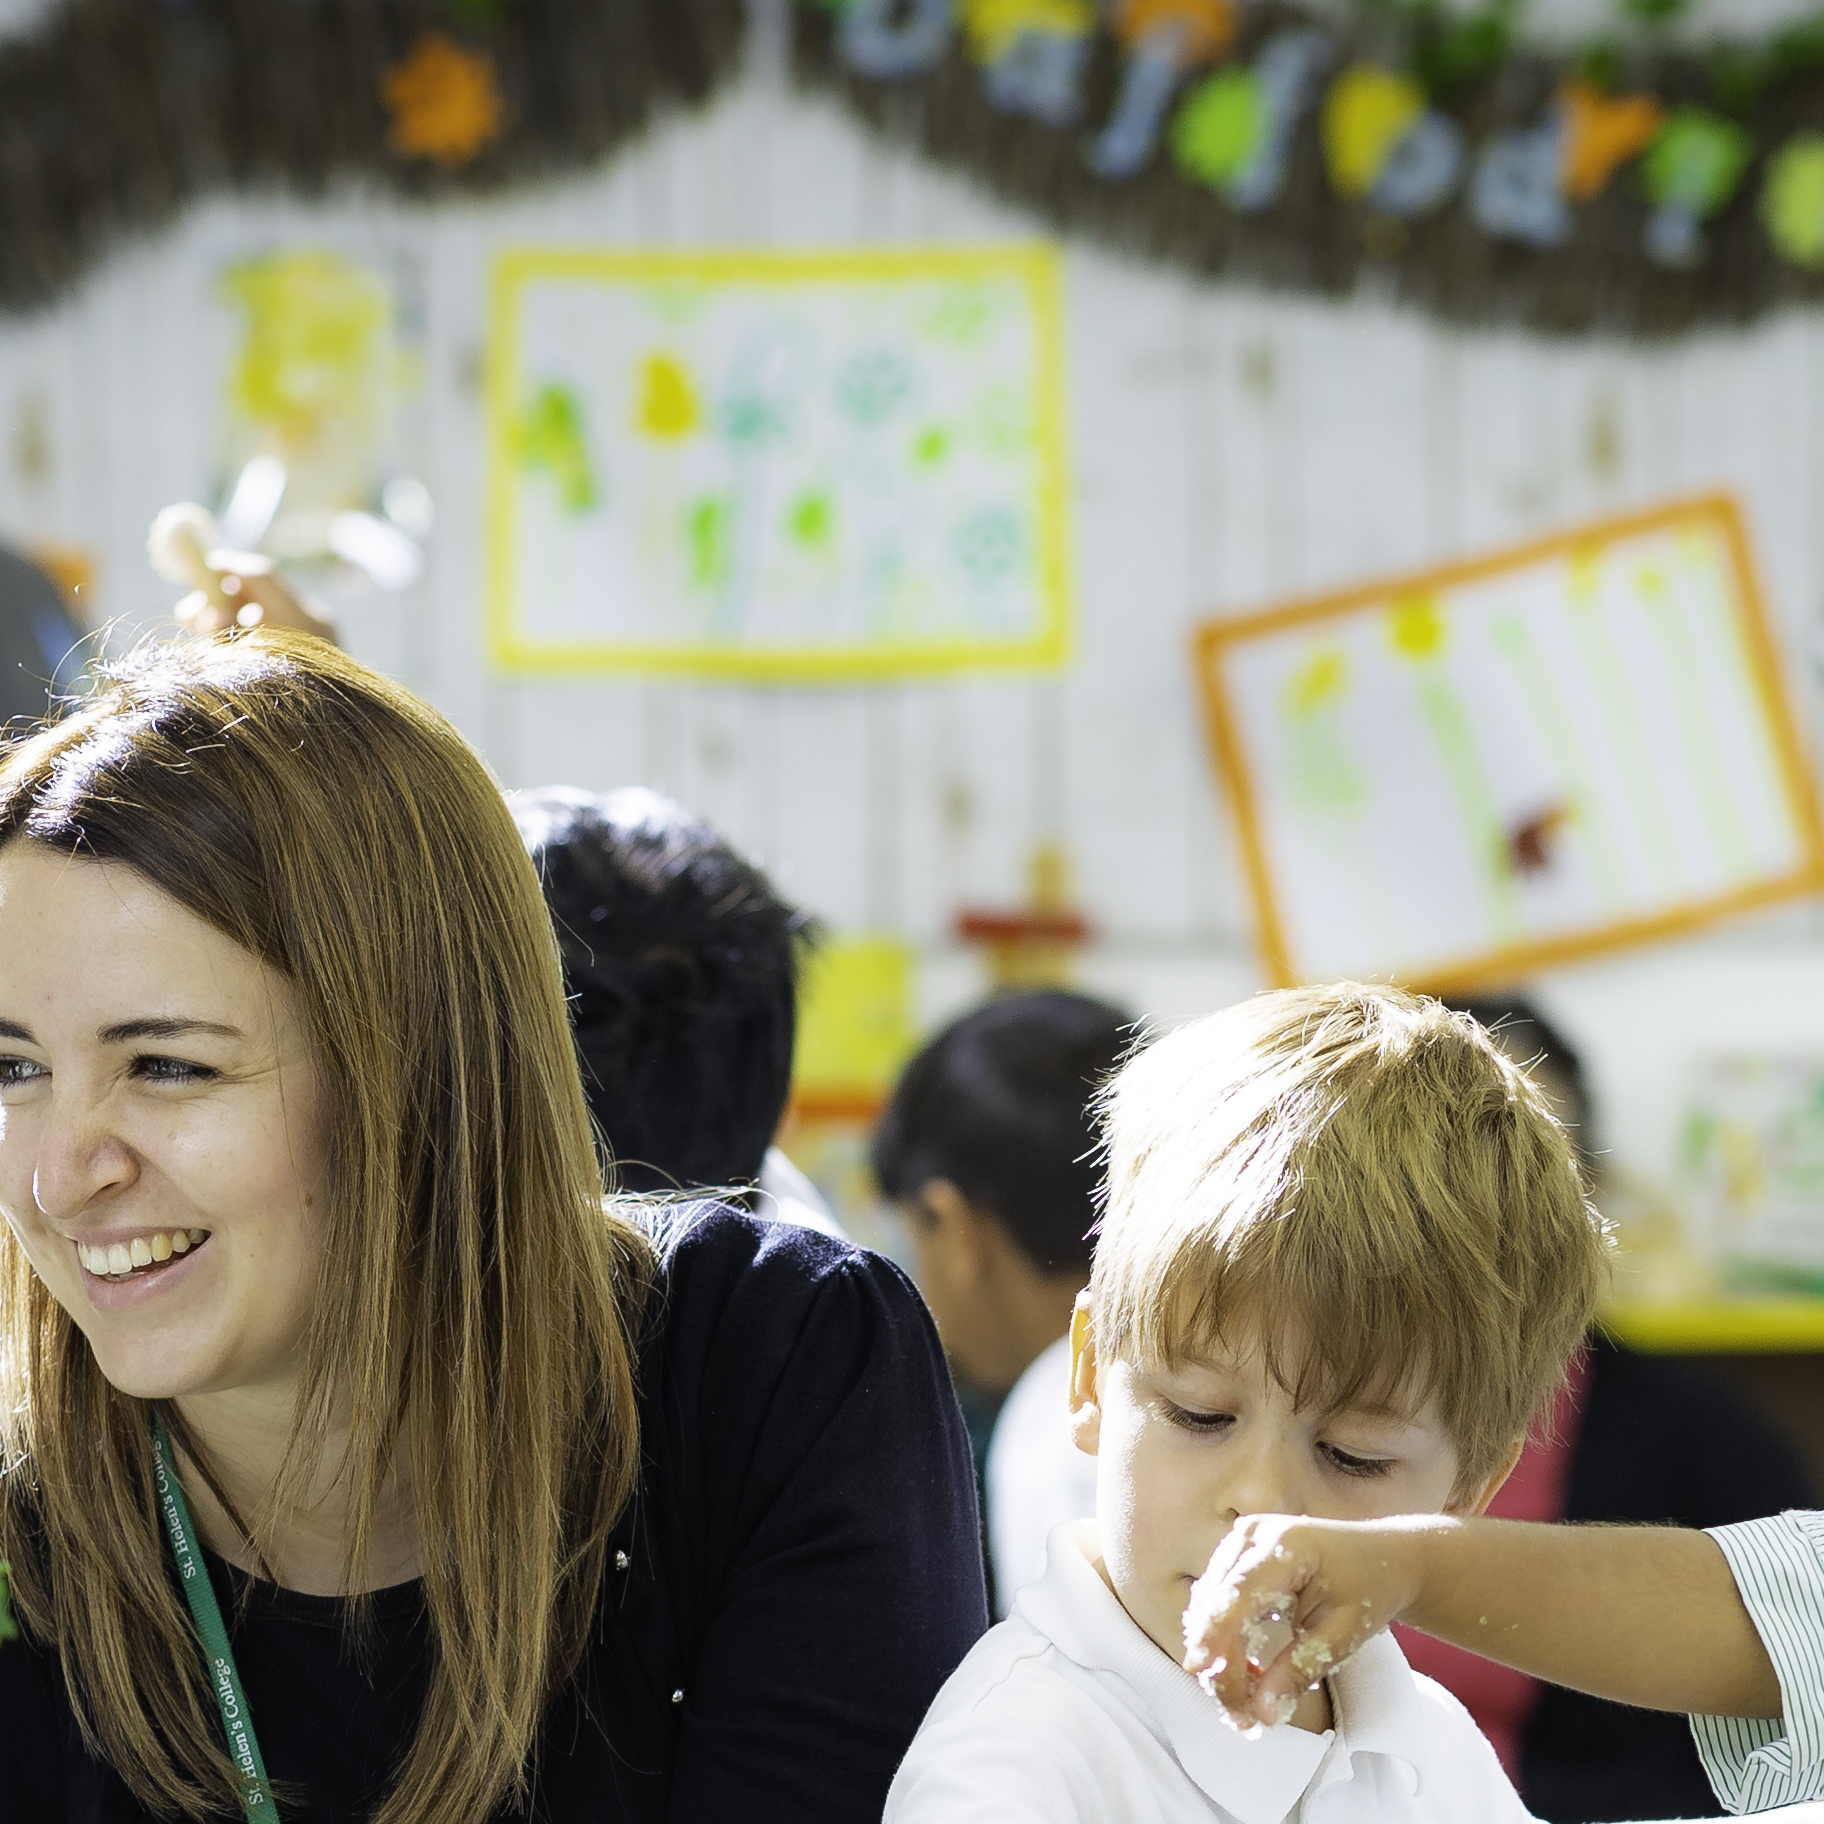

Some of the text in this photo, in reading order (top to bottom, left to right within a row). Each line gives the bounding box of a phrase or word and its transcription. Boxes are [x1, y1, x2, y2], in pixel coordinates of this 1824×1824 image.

[163, 1494, 189, 1555] Helen's
[183, 1556, 197, 1579] St.
[214, 1657, 239, 1719] College
